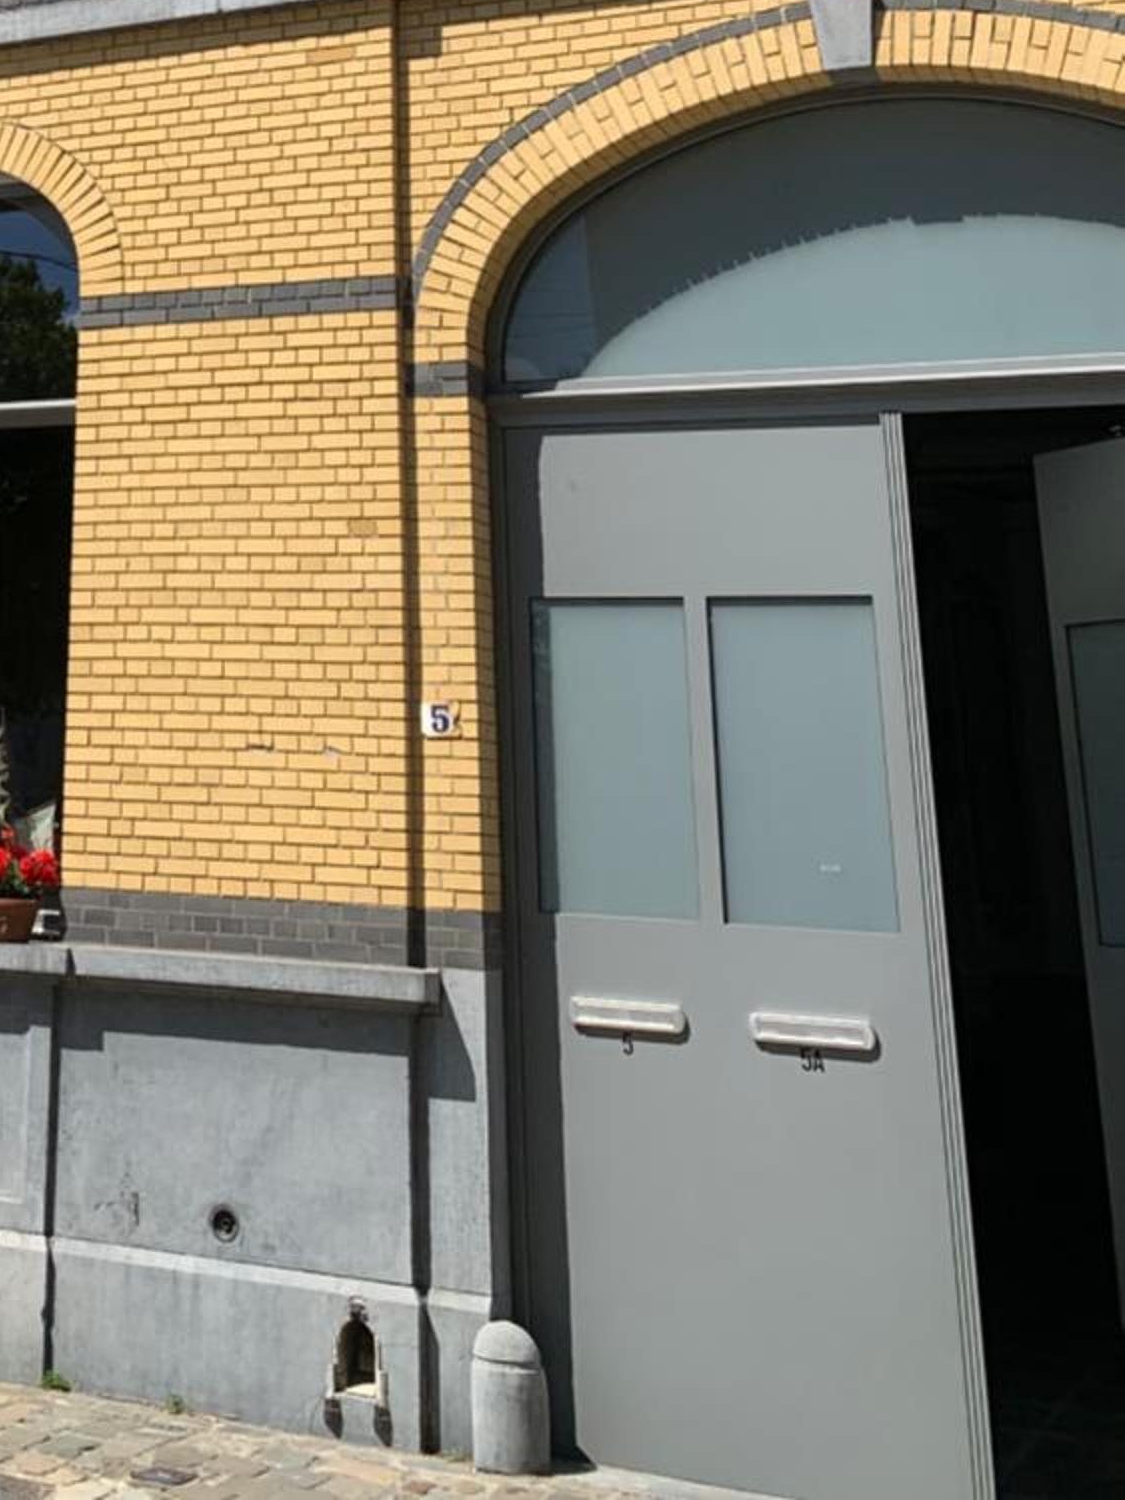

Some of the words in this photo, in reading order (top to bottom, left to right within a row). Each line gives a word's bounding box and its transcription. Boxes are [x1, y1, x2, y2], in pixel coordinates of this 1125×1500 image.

[430, 705, 450, 733] 5
[622, 1030, 634, 1055] 5
[800, 1046, 826, 1073] 5A
